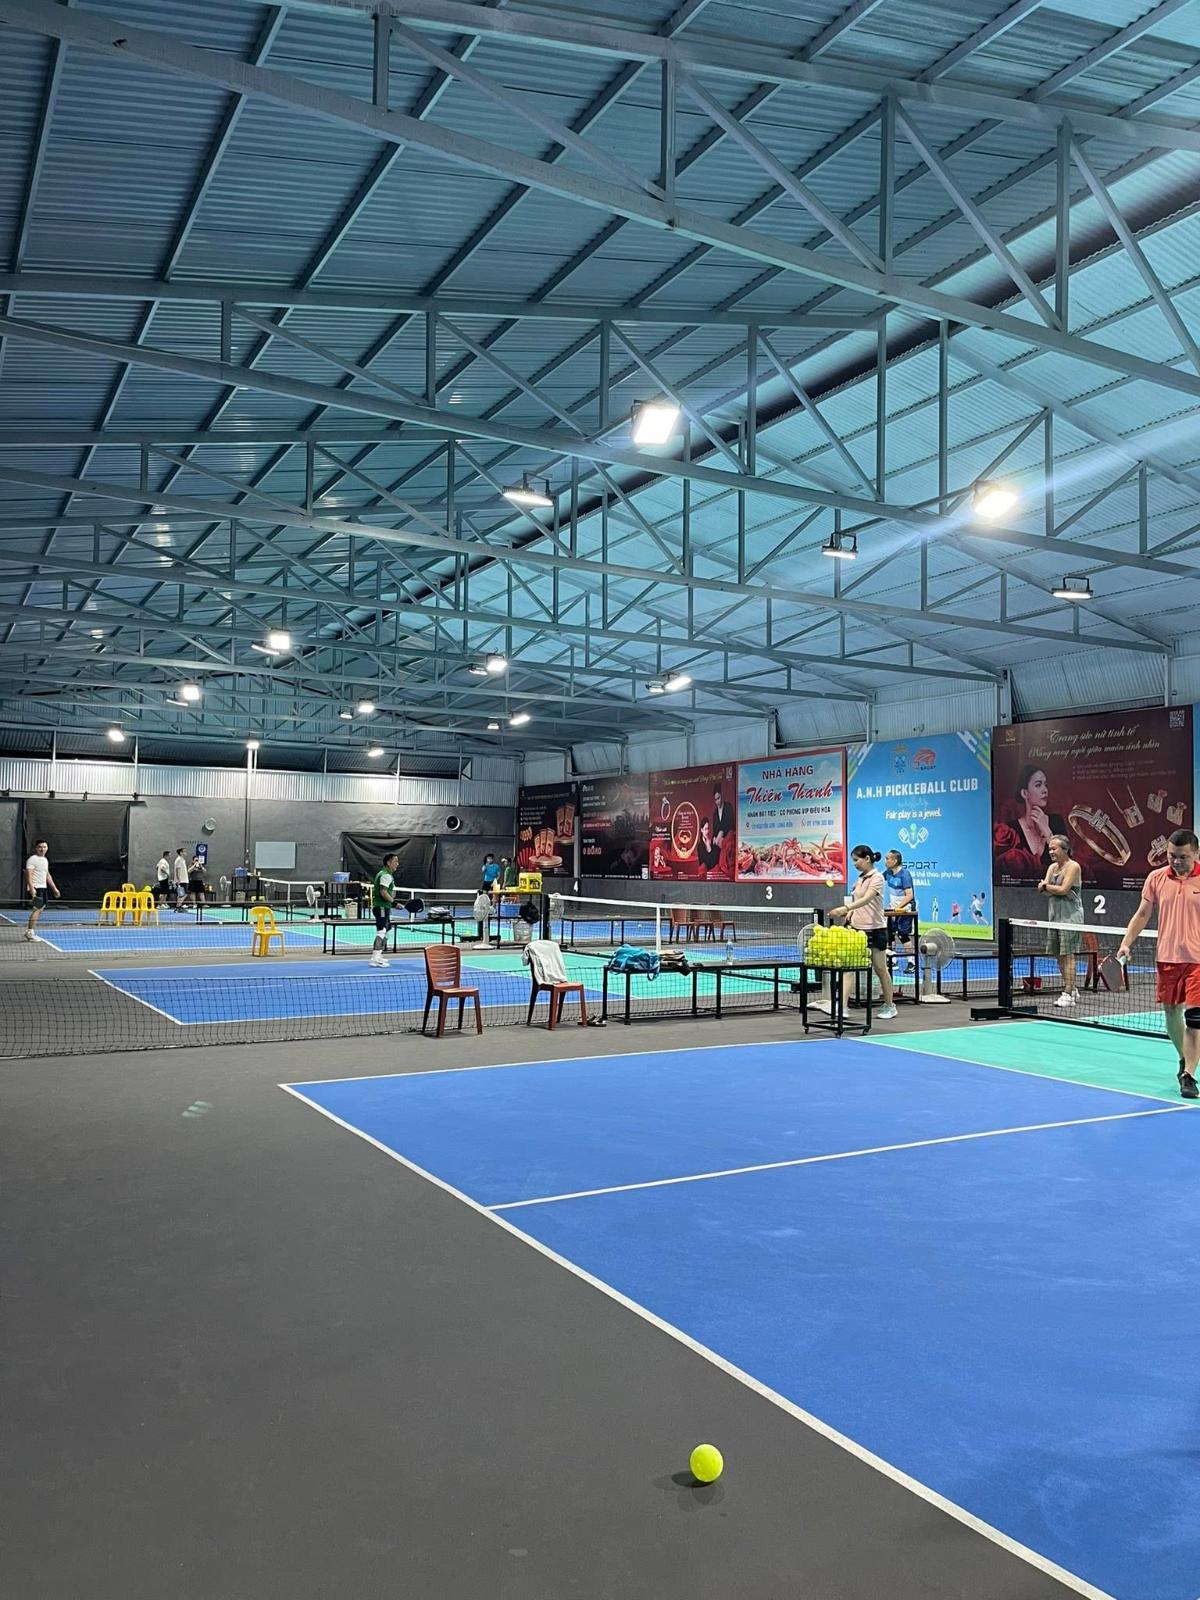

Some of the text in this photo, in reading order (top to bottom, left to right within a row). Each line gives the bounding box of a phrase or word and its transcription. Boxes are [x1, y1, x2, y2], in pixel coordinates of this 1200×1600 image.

[762, 765, 814, 780] NHÀ HÀNG
[746, 780, 833, 805] Thiên Thanh
[856, 778, 978, 799] A.N.H PICKLEBALL CLUB
[885, 810, 897, 819] Fair
[898, 809, 911, 820] play
[912, 808, 917, 818] is
[918, 810, 923, 818] a
[765, 885, 773, 900] 3
[1093, 895, 1106, 914] 2
